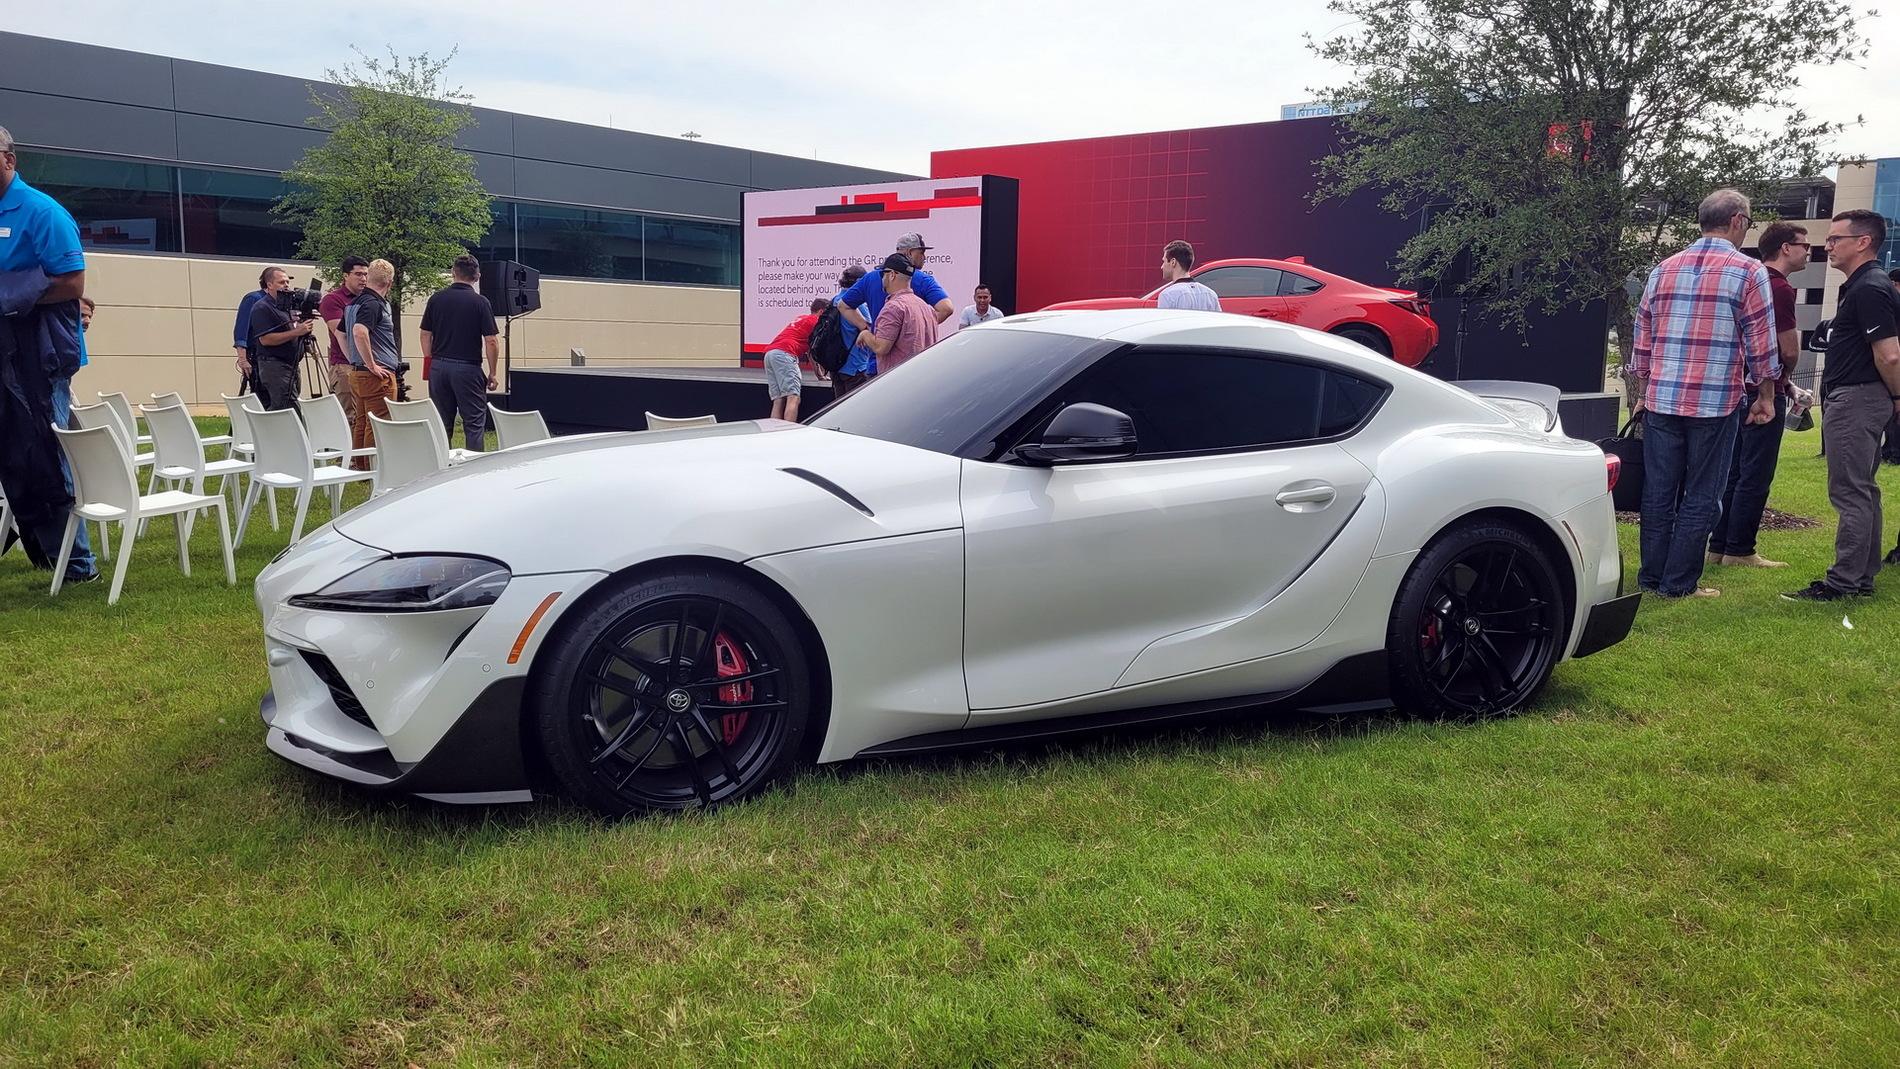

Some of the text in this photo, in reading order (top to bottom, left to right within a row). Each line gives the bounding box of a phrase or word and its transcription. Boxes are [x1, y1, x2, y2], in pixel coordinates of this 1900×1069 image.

[758, 258, 780, 268] Thank
[781, 259, 794, 269] you
[797, 256, 808, 266] for
[810, 256, 847, 268] attending
[849, 256, 862, 266] the
[864, 255, 876, 265] GR
[758, 271, 840, 282] please make your way
[758, 284, 786, 294] located
[787, 284, 813, 294] behind
[815, 286, 831, 296] you.
[758, 298, 813, 307] is scheduled to
